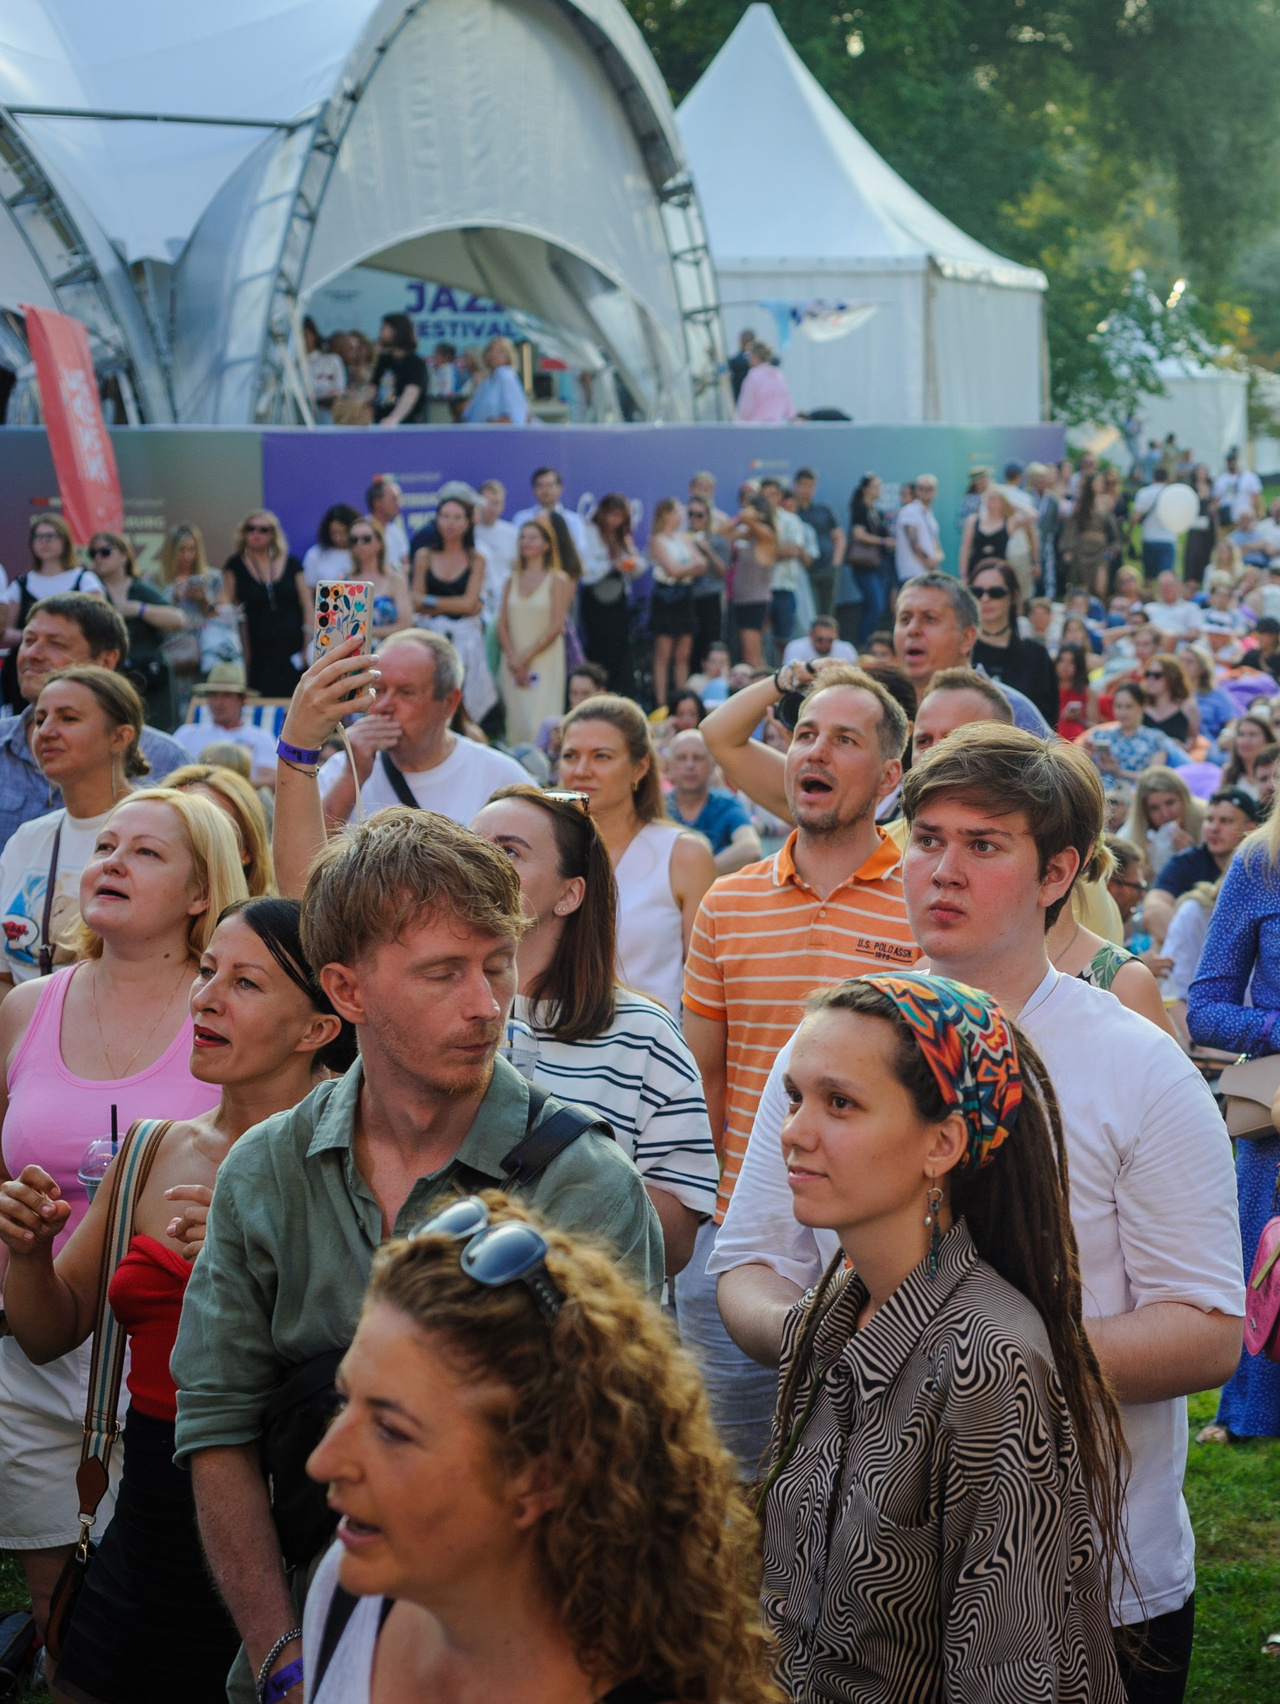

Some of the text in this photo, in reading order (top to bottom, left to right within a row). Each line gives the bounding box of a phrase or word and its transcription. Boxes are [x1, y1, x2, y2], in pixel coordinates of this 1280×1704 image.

[405, 282, 504, 313] JAZ
[417, 321, 516, 338] ESTIVAL
[857, 938, 913, 958] U.S. POLO ASSN.
